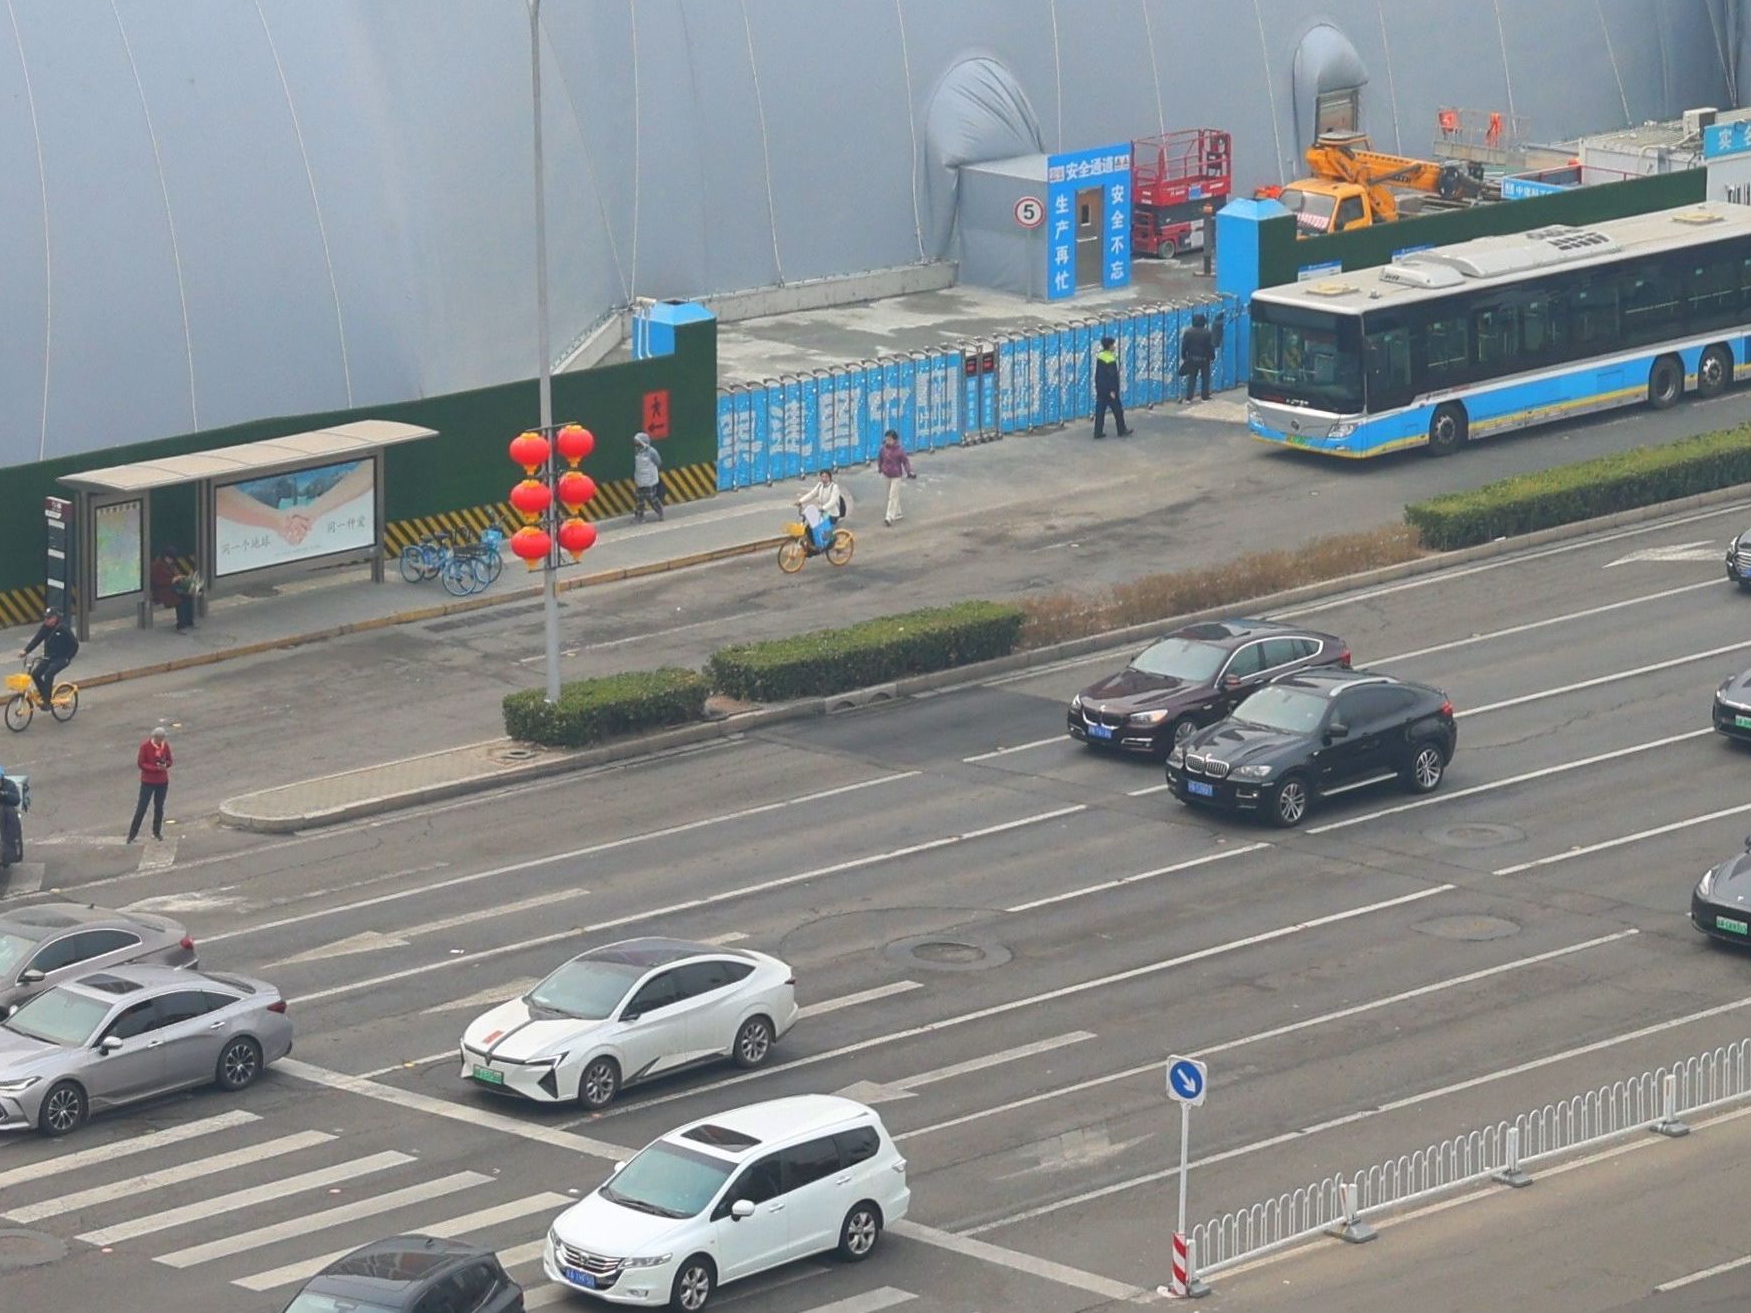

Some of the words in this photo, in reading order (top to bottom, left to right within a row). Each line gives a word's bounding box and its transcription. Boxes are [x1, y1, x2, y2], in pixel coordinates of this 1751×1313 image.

[1066, 155, 1114, 182] 安全通道
[1023, 204, 1035, 221] 5
[1055, 192, 1070, 291] 生产再忙
[1110, 184, 1125, 280] 安全不忘
